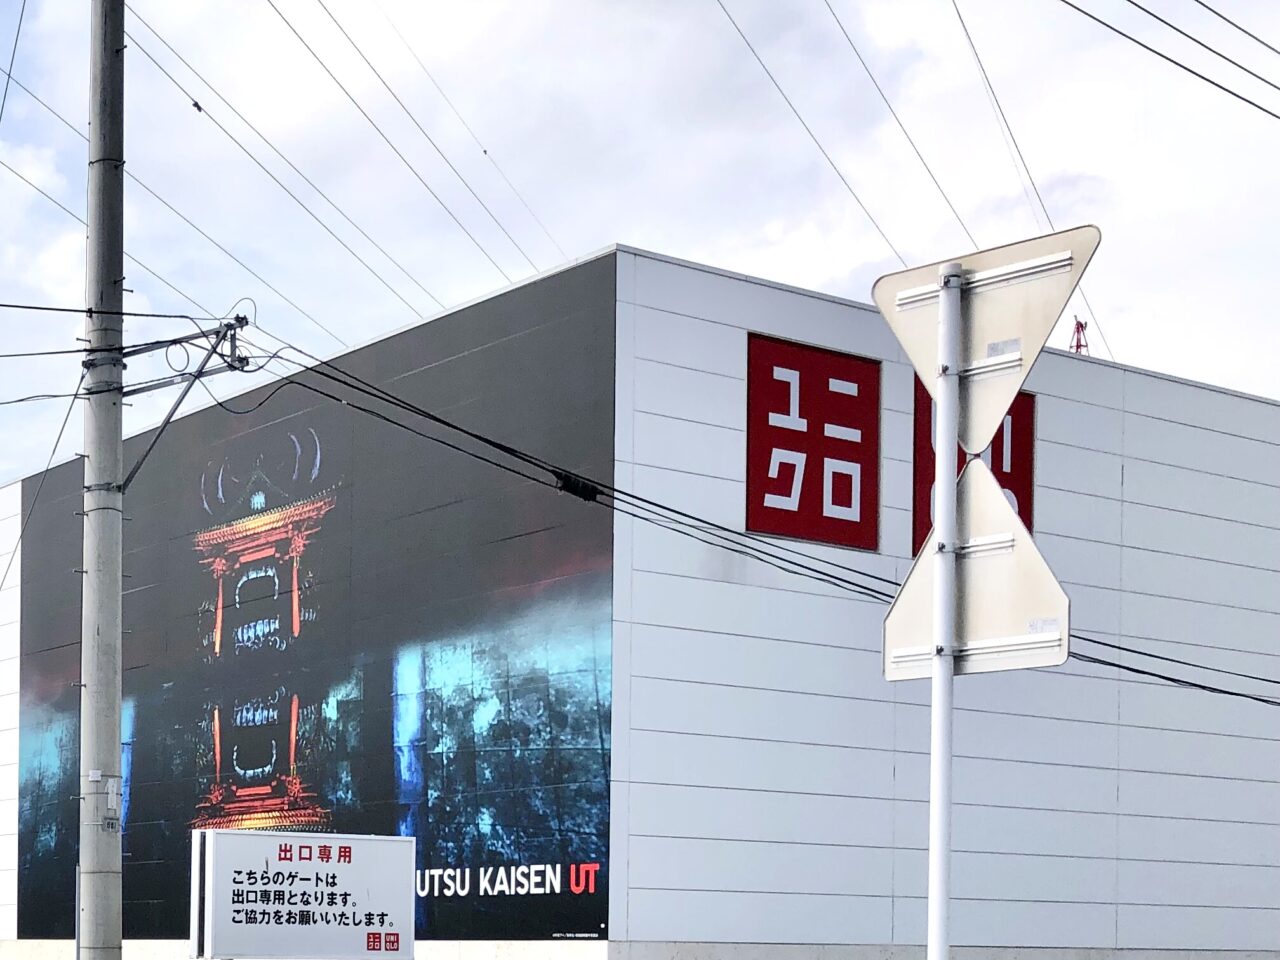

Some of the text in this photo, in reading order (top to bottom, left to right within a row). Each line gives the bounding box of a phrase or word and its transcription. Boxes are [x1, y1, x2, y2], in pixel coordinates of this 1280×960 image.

[278, 843, 352, 864] 出口専用
[232, 870, 338, 887] こちらのゲートは
[479, 864, 561, 896] KAISEN
[570, 863, 600, 894] UT
[231, 889, 357, 907] 出口専用となります。
[231, 909, 394, 928] ご協力をお願いいたします。
